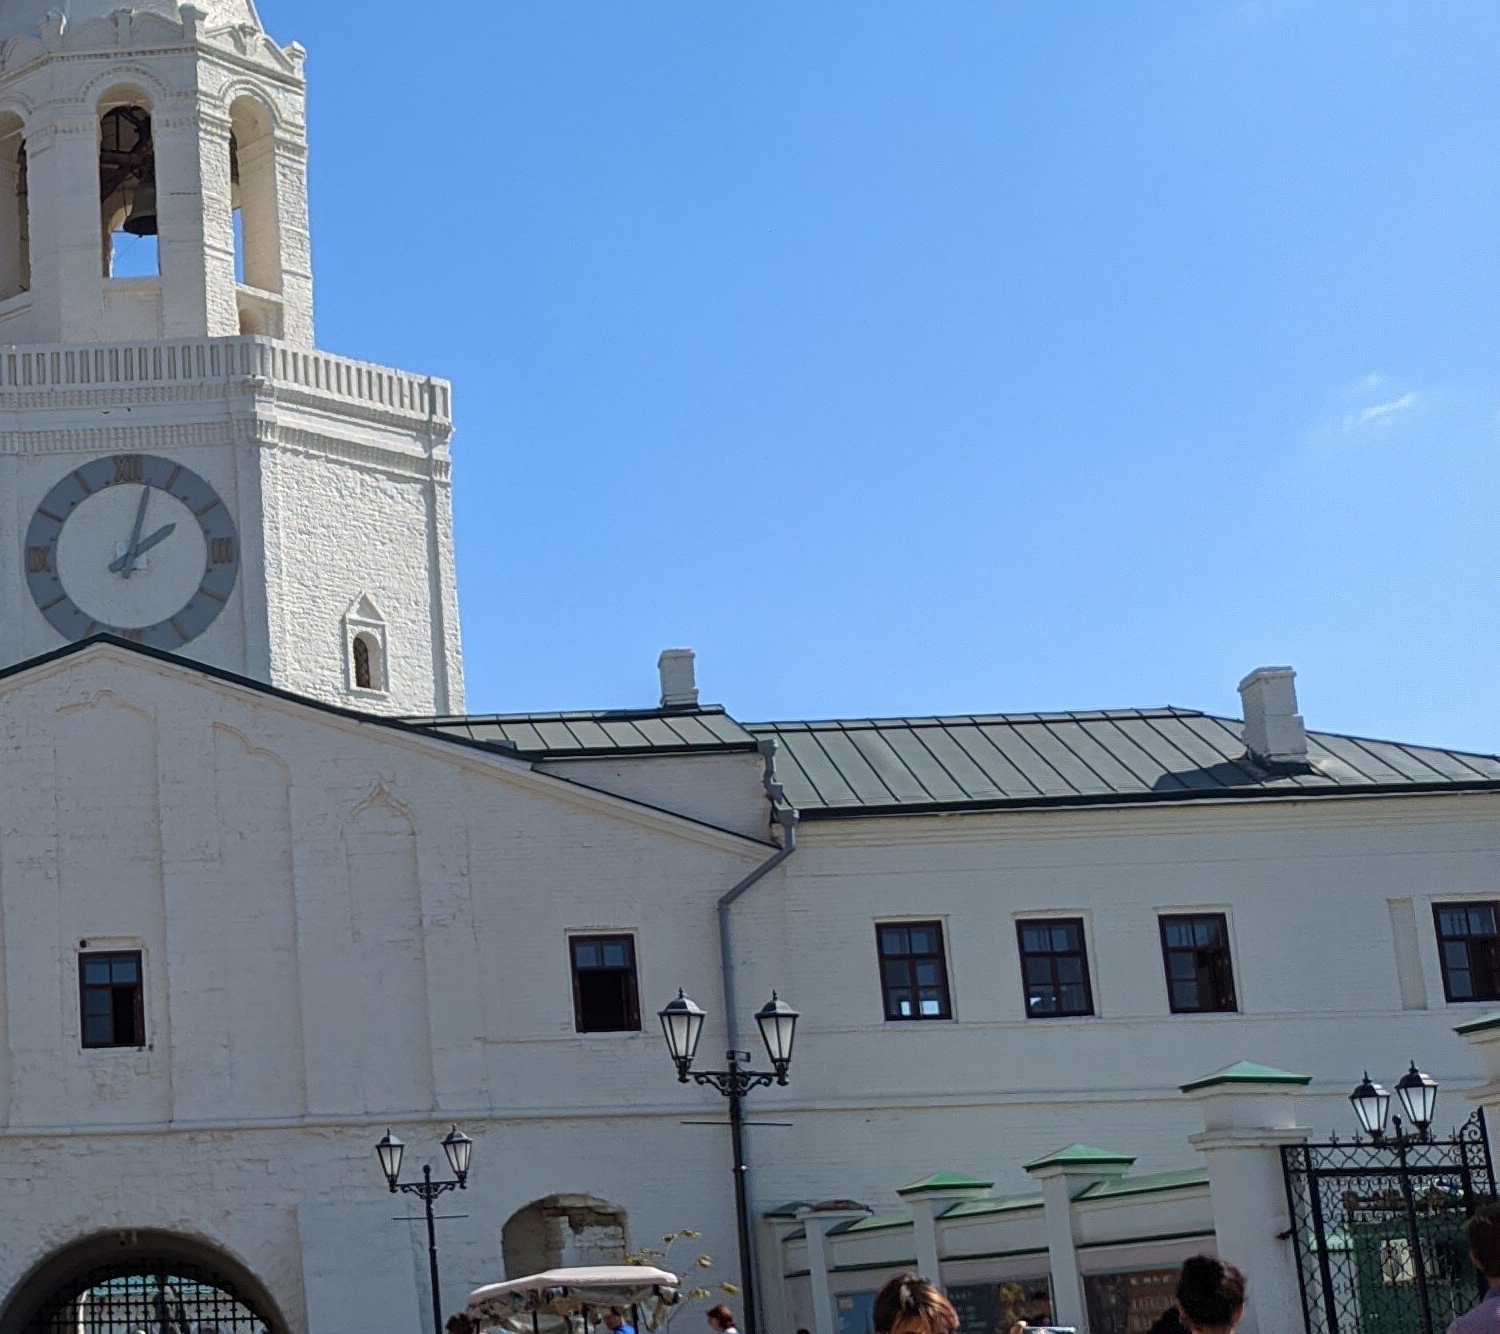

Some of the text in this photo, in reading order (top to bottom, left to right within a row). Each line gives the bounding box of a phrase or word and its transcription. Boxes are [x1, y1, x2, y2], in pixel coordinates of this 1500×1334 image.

[112, 454, 143, 482] XII
[27, 545, 49, 573] IX
[211, 536, 233, 563] III
